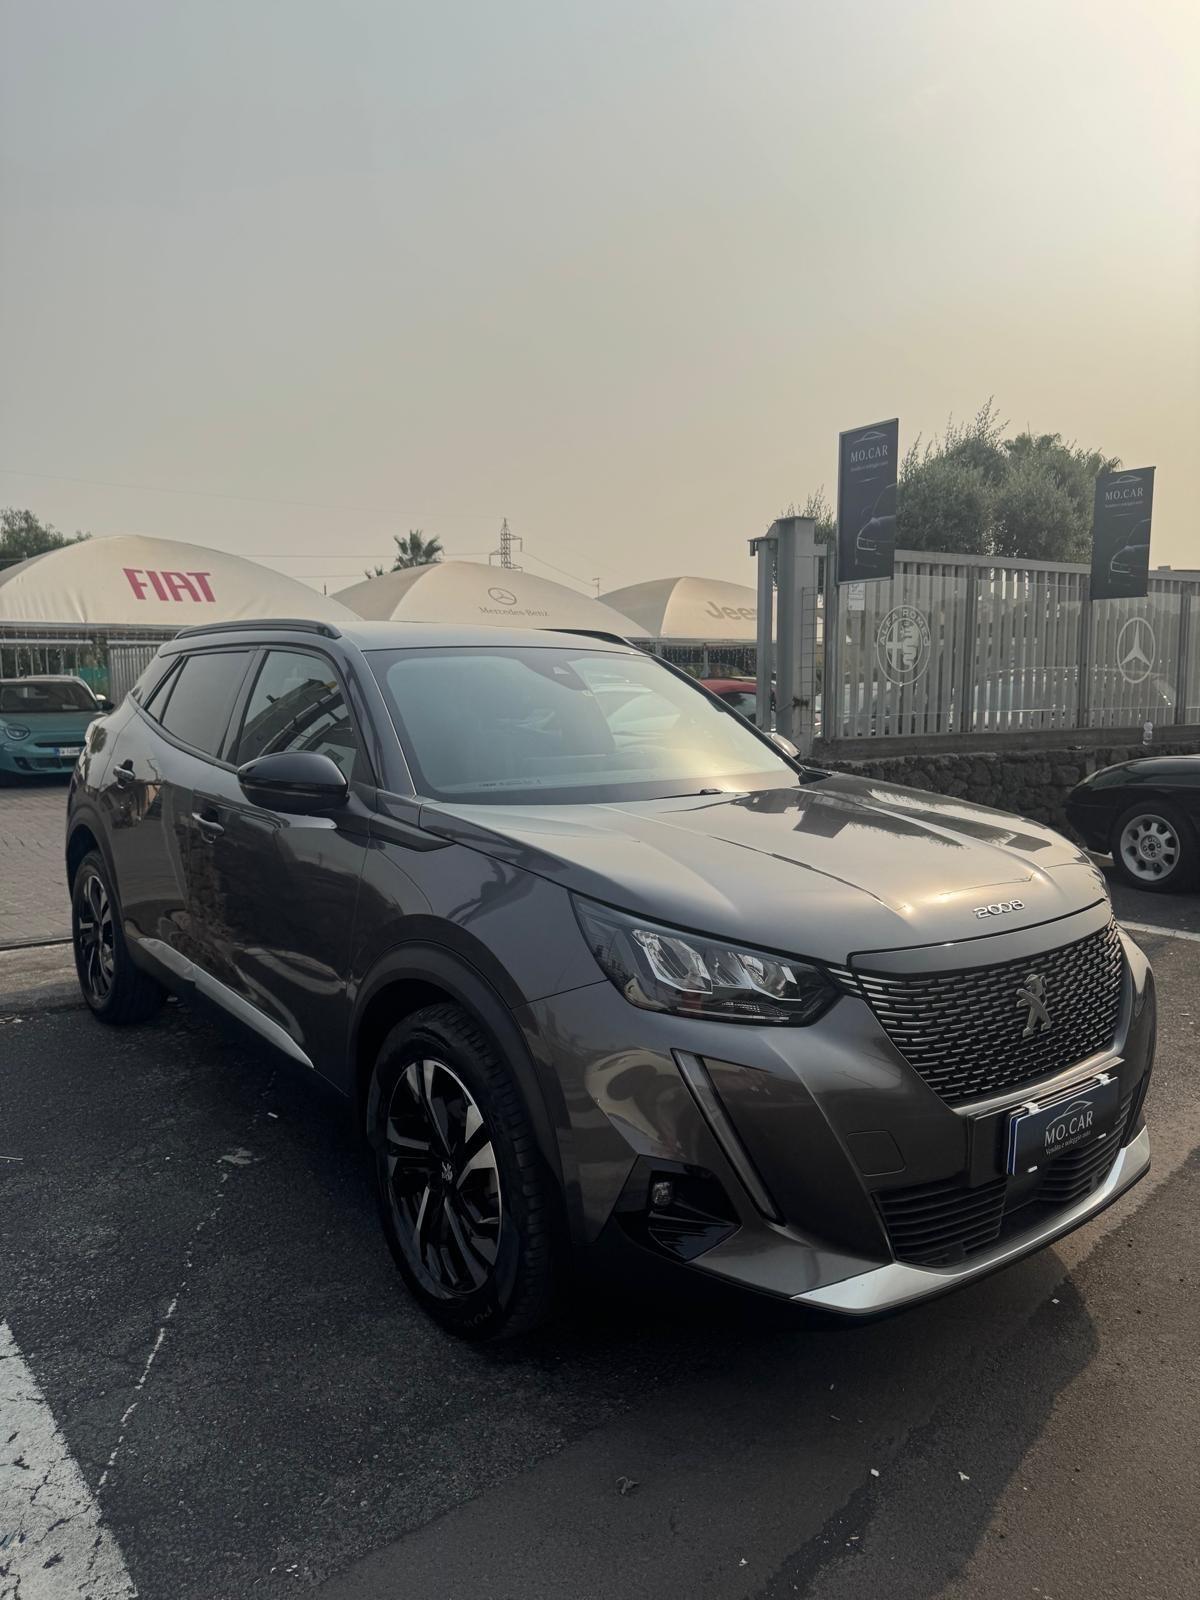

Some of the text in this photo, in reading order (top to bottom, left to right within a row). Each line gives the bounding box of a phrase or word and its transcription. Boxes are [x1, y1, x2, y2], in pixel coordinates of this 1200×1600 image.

[850, 444, 888, 462] MO.CAR
[1105, 487, 1144, 500] MO.CAR
[122, 568, 216, 603] FIAT
[704, 601, 757, 621] Jee
[881, 610, 930, 647] ALFA ROMEO
[974, 900, 1025, 919] 2008
[1044, 1110, 1093, 1147] MO.CAR
